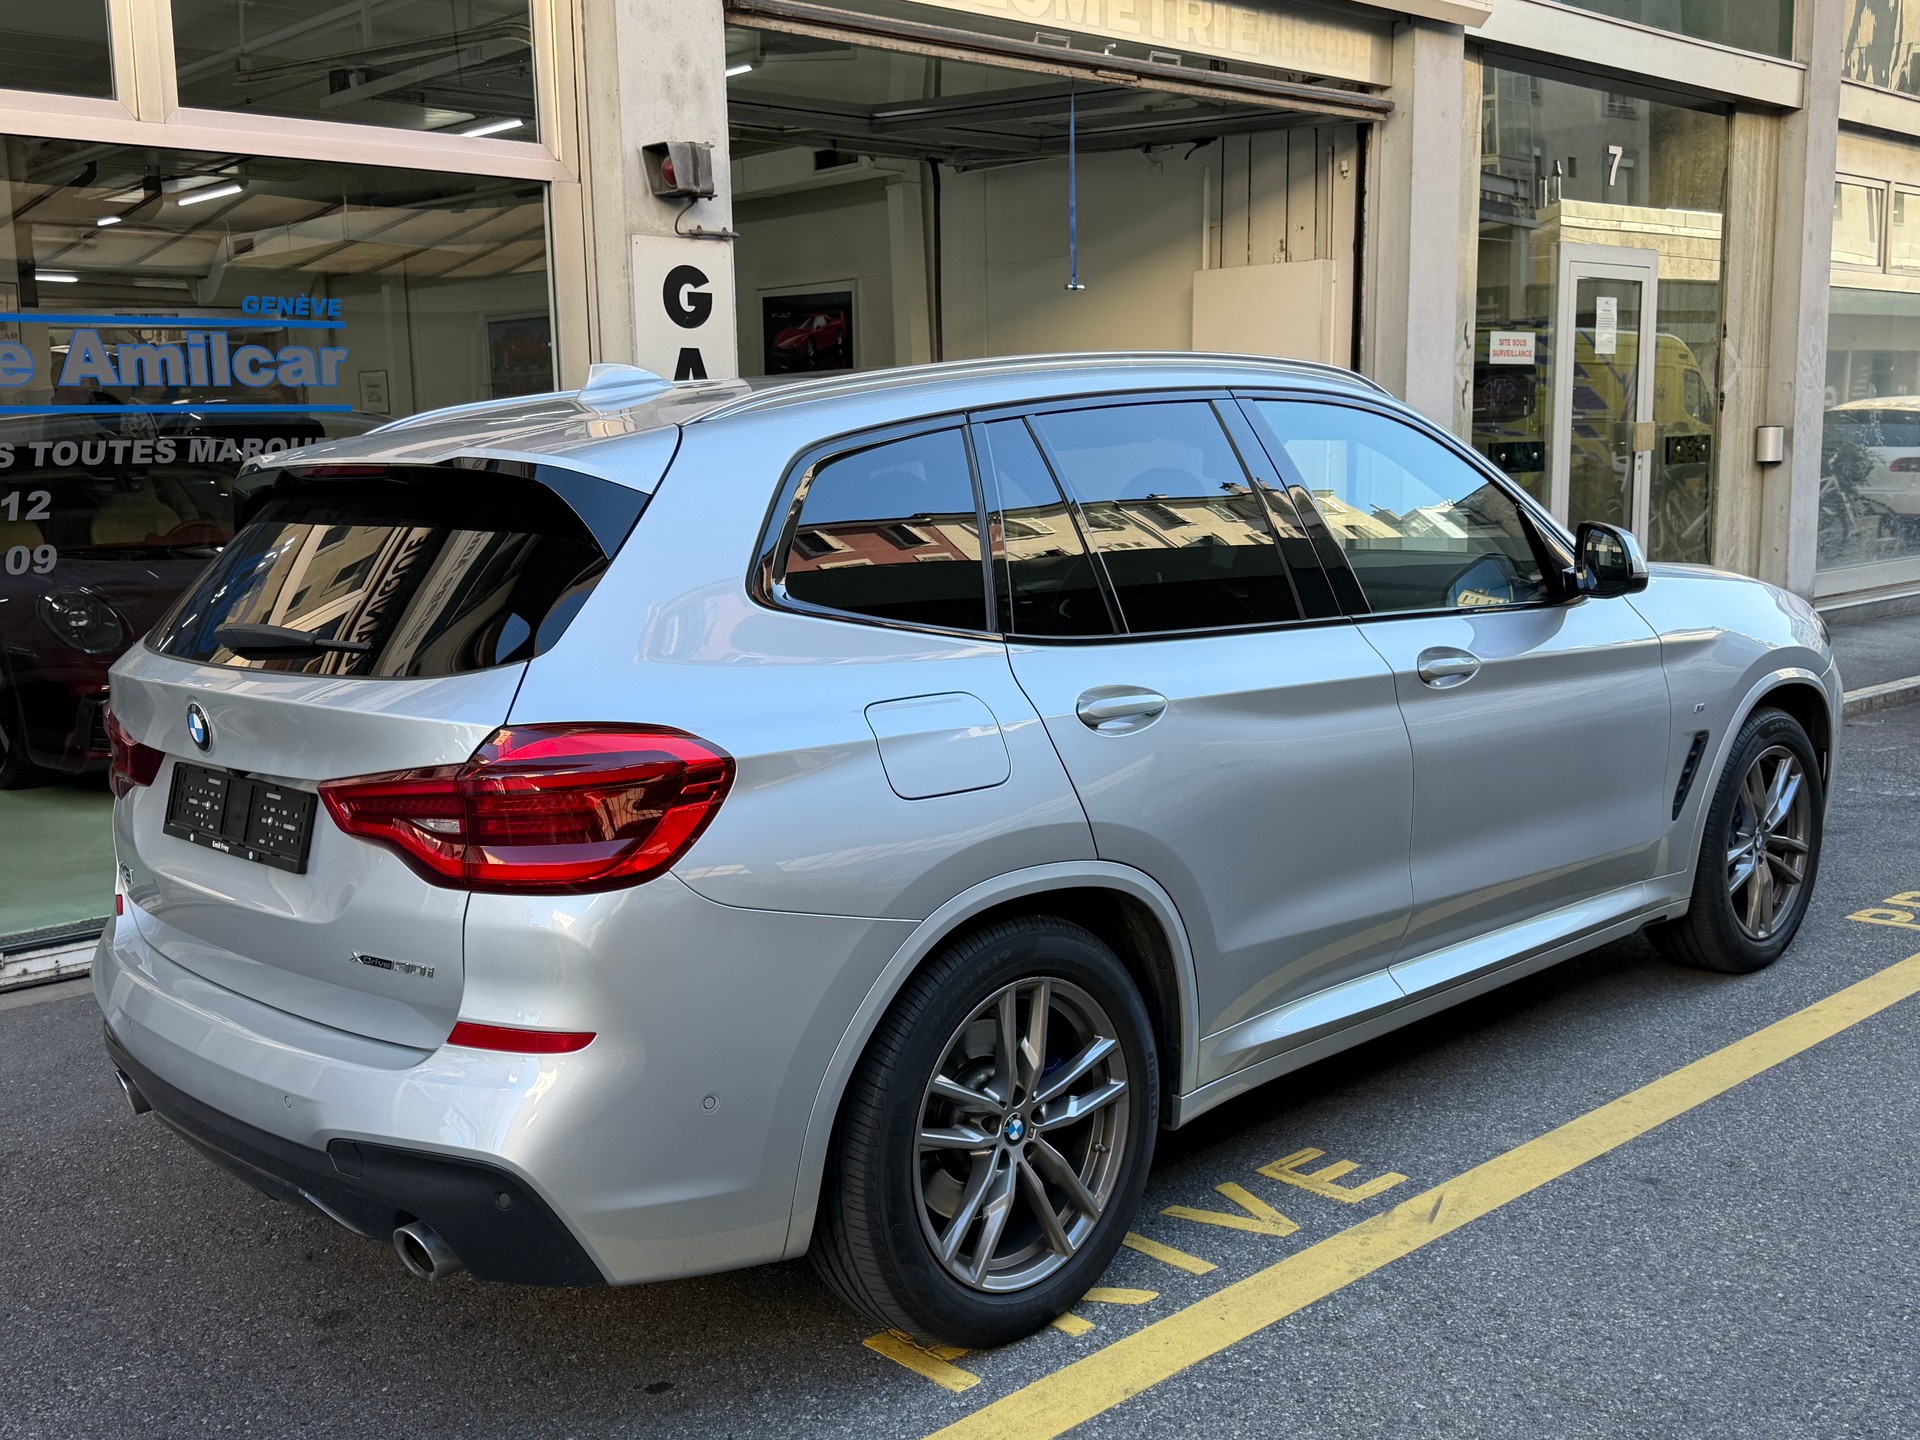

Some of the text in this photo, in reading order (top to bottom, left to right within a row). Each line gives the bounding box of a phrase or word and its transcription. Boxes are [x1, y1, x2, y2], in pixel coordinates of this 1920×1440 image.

[1608, 145, 1623, 186] 7
[242, 293, 343, 317] GENÈVE
[58, 328, 348, 387] Amilcar
[1492, 349, 1533, 358] SURVEILLANCE
[1498, 338, 1527, 347] SITE SOUS
[28, 439, 177, 467] TOUTES
[188, 436, 334, 464] MARQ
[1, 490, 52, 522] 12
[5, 544, 58, 576] 09
